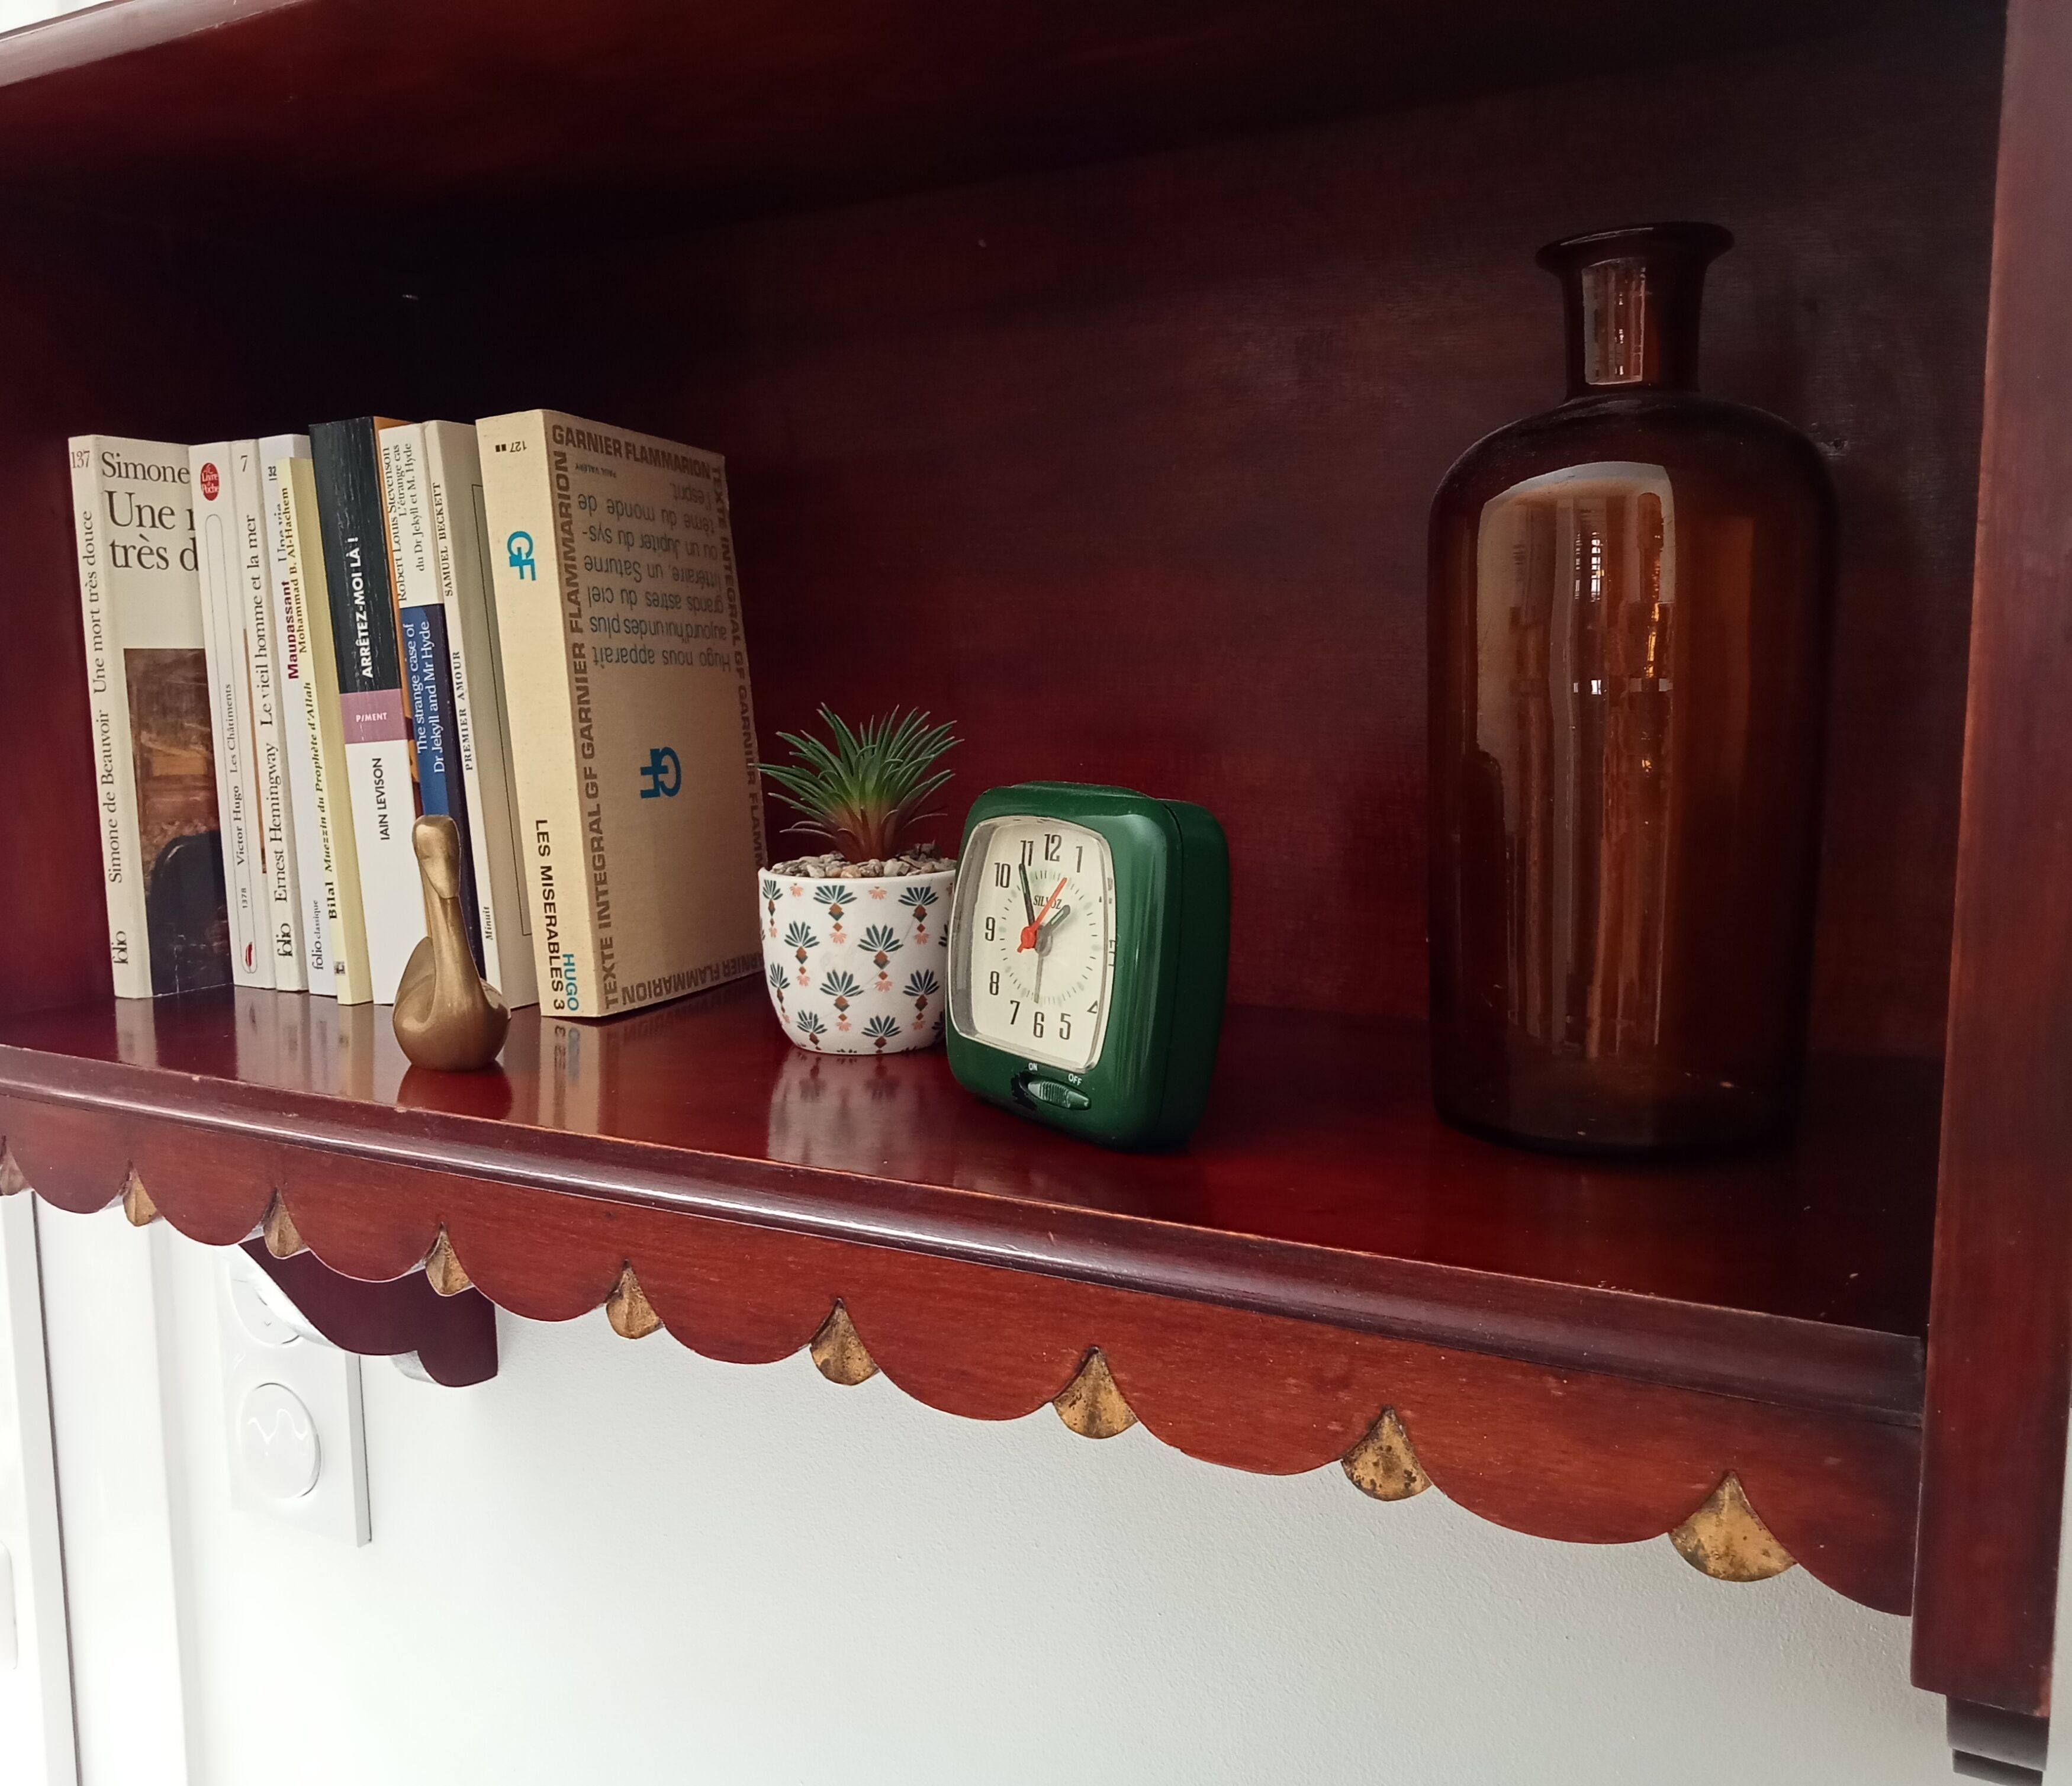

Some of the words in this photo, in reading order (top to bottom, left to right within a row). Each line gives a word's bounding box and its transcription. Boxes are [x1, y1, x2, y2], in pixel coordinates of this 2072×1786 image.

[72, 450, 90, 468] 137
[404, 443, 416, 472] Hyde
[510, 440, 527, 453] 127
[552, 424, 623, 458] GARNIER
[625, 442, 711, 480] FLAMMARION
[102, 451, 189, 484] Simone
[240, 455, 247, 472] 7
[382, 447, 397, 513] Stevenson
[395, 465, 407, 517] L'étrange
[408, 475, 416, 490] M.
[104, 490, 175, 530] Une
[410, 493, 417, 504] et
[433, 482, 447, 539] BECKETT
[578, 494, 597, 517] de
[607, 500, 655, 523] monde
[712, 466, 727, 529] TEXTE
[247, 515, 258, 549] mer
[282, 487, 295, 558] Al-Hachem
[390, 514, 401, 552] Louis
[411, 507, 424, 536] Jekyll
[582, 522, 612, 545] sys-
[661, 510, 677, 529] du
[683, 516, 715, 535] tème
[83, 511, 95, 565] douce
[110, 533, 169, 570] très
[414, 538, 423, 554] Dr
[553, 451, 584, 633] FLAMMARION
[618, 530, 634, 551] du
[640, 533, 681, 556] Jupiter
[685, 542, 699, 556] un
[703, 545, 718, 558] ou
[247, 554, 259, 570] la
[289, 562, 297, 574] B.
[346, 547, 361, 568] LÀ
[416, 555, 425, 572] du
[507, 530, 536, 581] GF
[584, 555, 641, 583] Saturne
[250, 574, 261, 590] et
[395, 556, 407, 601] Robert
[440, 546, 453, 597] SAMUEL
[646, 563, 662, 578] un
[668, 565, 721, 591] littéraire,
[85, 571, 99, 602] très
[587, 586, 613, 607] ciel
[620, 589, 637, 611] du
[645, 592, 681, 609] astres
[720, 536, 741, 646] INTEGRAL
[291, 578, 307, 653] Mohammad
[687, 594, 723, 615] grands
[90, 608, 103, 651] mort
[253, 595, 268, 657] homme
[282, 580, 299, 680] Maupassant
[352, 571, 374, 678] ARRÊTEZ-MOI
[403, 623, 414, 641] of
[590, 617, 620, 639] plus
[624, 620, 646, 639] des
[419, 620, 435, 661] Hyde
[407, 642, 419, 671] case
[592, 643, 655, 668] apparaît
[662, 650, 693, 666] nous
[700, 648, 731, 672] Hugo
[734, 651, 745, 679] GF
[93, 657, 107, 693] Une
[256, 664, 269, 698] vieil
[424, 662, 435, 682] Mr
[453, 651, 466, 700] AMOUR
[304, 683, 316, 731] d'Allah
[411, 674, 424, 723] strange
[426, 684, 437, 712] and
[572, 642, 595, 760] GARNIER
[225, 684, 236, 752] Châtiments
[260, 703, 272, 726] Le
[355, 712, 388, 723] PIMENT
[96, 710, 114, 785] Beauvoir
[416, 726, 427, 754] The
[429, 713, 443, 753] Jekyll
[459, 708, 473, 771] PREMIER
[738, 685, 756, 786] GARNIER
[311, 735, 323, 791] Prophète
[433, 755, 445, 773] Dr
[266, 742, 282, 842] Hemingway
[371, 758, 388, 811] LEVISON
[585, 767, 599, 799] GF
[104, 791, 116, 813] de
[233, 785, 242, 821] Hugo
[317, 797, 324, 812] du
[379, 814, 390, 841] IAIN
[536, 819, 551, 857] LES
[108, 819, 121, 883] Simone
[236, 825, 244, 865] Victor
[320, 816, 333, 872] Muezzin
[1020, 840, 1034, 866] 11
[1044, 834, 1062, 861] 12
[588, 804, 612, 929] INTEGRAL
[1076, 846, 1083, 873] 1
[273, 849, 287, 902] Ernest
[994, 863, 1011, 889] 10
[324, 882, 337, 919] Bilal
[313, 900, 322, 939] classique
[540, 865, 564, 992] MISERABLES
[984, 916, 996, 941] 9
[111, 931, 127, 965] folio
[277, 922, 293, 957] folio
[311, 940, 323, 970] folio
[562, 954, 579, 1011] HUGO
[600, 936, 619, 1009] TEXTE
[622, 962, 721, 1005] FLAMMARION
[989, 971, 999, 995] 8
[554, 1000, 565, 1010] 3
[1011, 1000, 1020, 1025] 7
[1034, 1012, 1044, 1038] 6
[1060, 1013, 1071, 1040] 5
[1068, 1074, 1082, 1085] OFF
